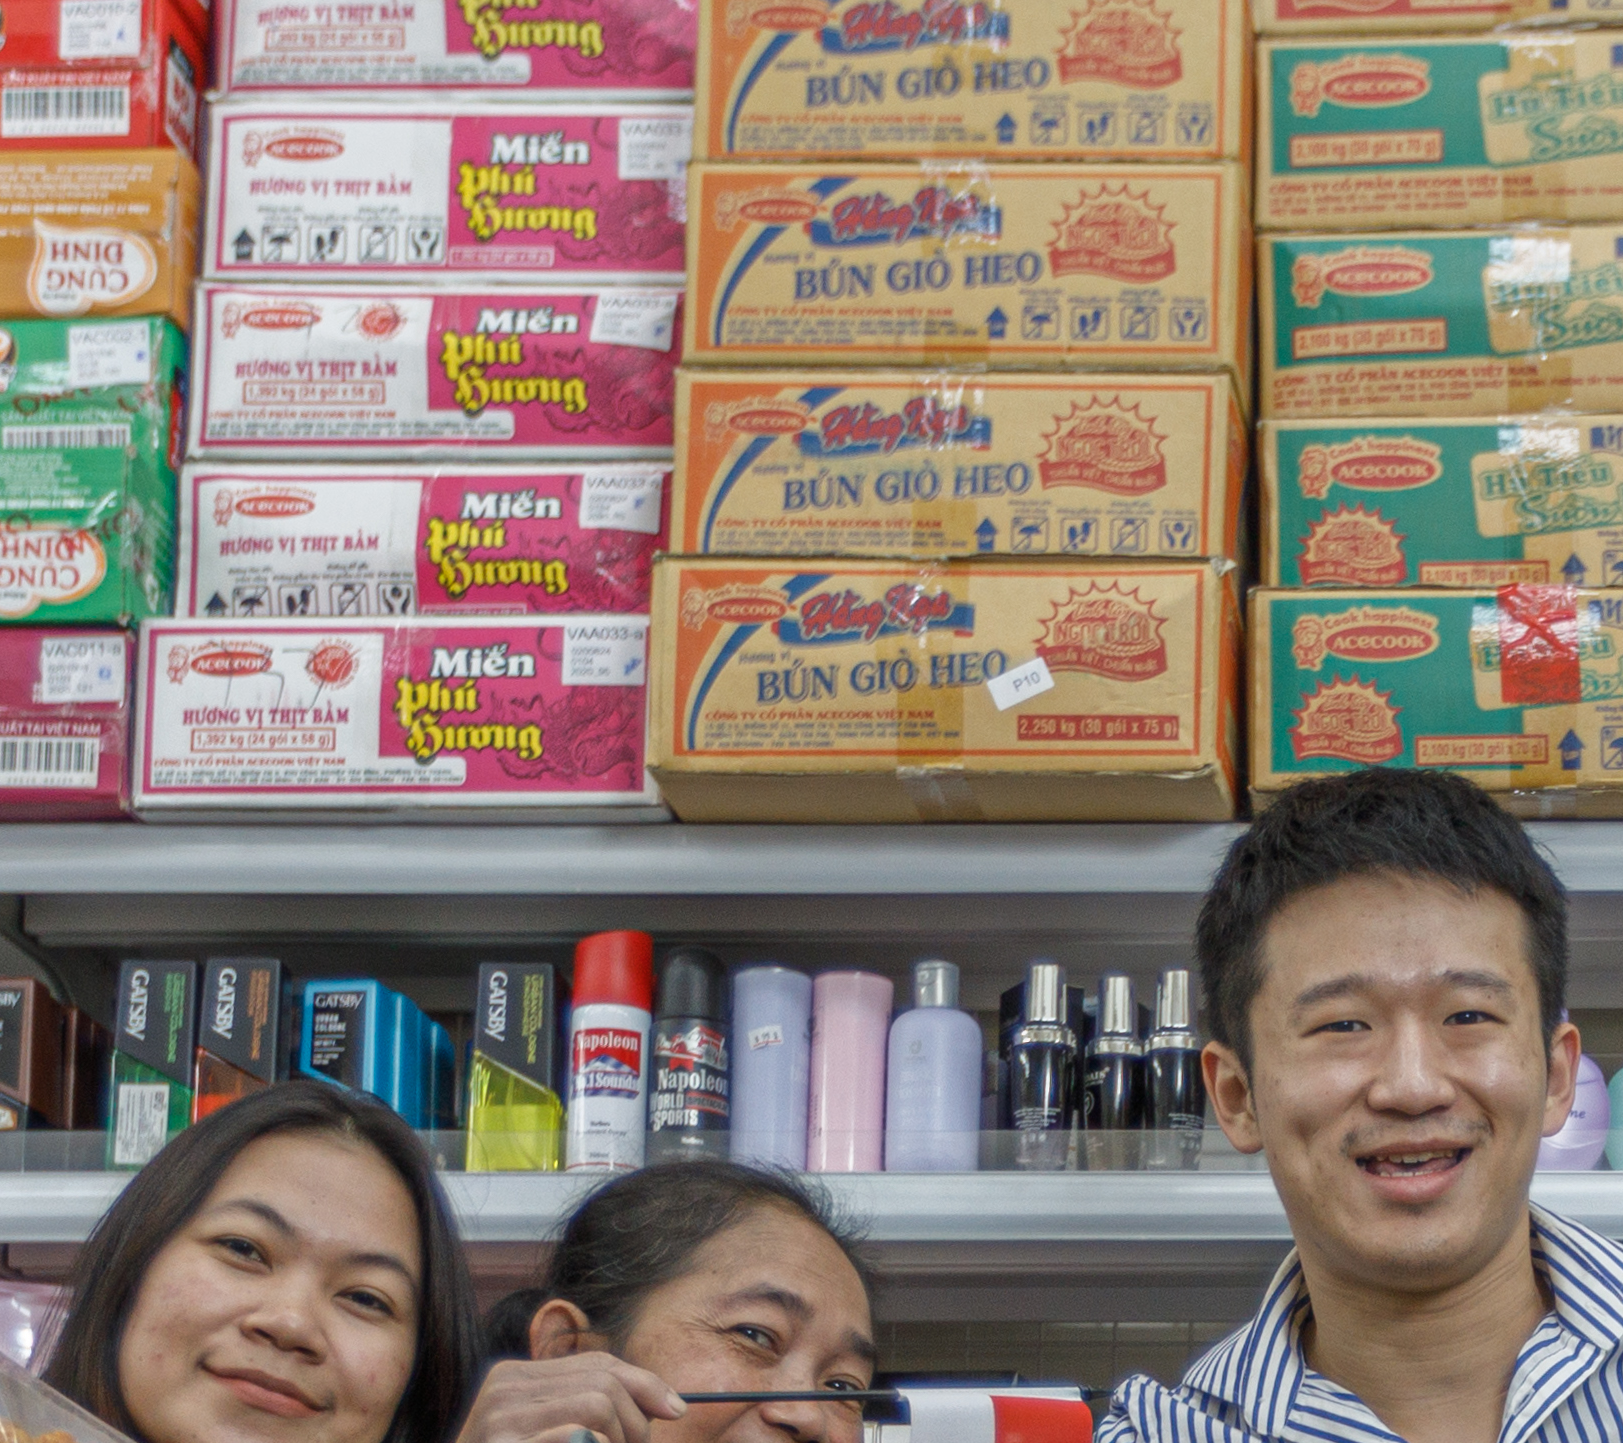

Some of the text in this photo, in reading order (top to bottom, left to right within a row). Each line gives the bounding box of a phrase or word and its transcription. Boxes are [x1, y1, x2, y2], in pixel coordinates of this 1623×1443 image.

[804, 54, 1050, 110] BÚN GIÒ HEO
[491, 131, 590, 165] Miến
[457, 162, 536, 212] Phú
[792, 243, 1044, 303] BÚN GIÒ HEO
[476, 308, 579, 335] Miến
[440, 331, 522, 380] Phú
[782, 455, 1032, 513] BÚN GIÒ HEO
[1337, 462, 1431, 480] ACECOOK
[462, 487, 561, 521] Miến
[423, 518, 507, 567] Phú
[430, 641, 535, 678] Miến
[1333, 633, 1431, 651] ACECOOK
[757, 649, 1008, 704] BÚN GIÒ HEO
[1012, 671, 1042, 693] P10
[394, 677, 481, 726] Phú
[128, 968, 151, 1042] GATSBY
[213, 966, 238, 1040] GATSBY
[313, 992, 365, 1011] GATSBY
[485, 970, 507, 1043] GATSBY
[651, 1110, 699, 1132] SPORTS
